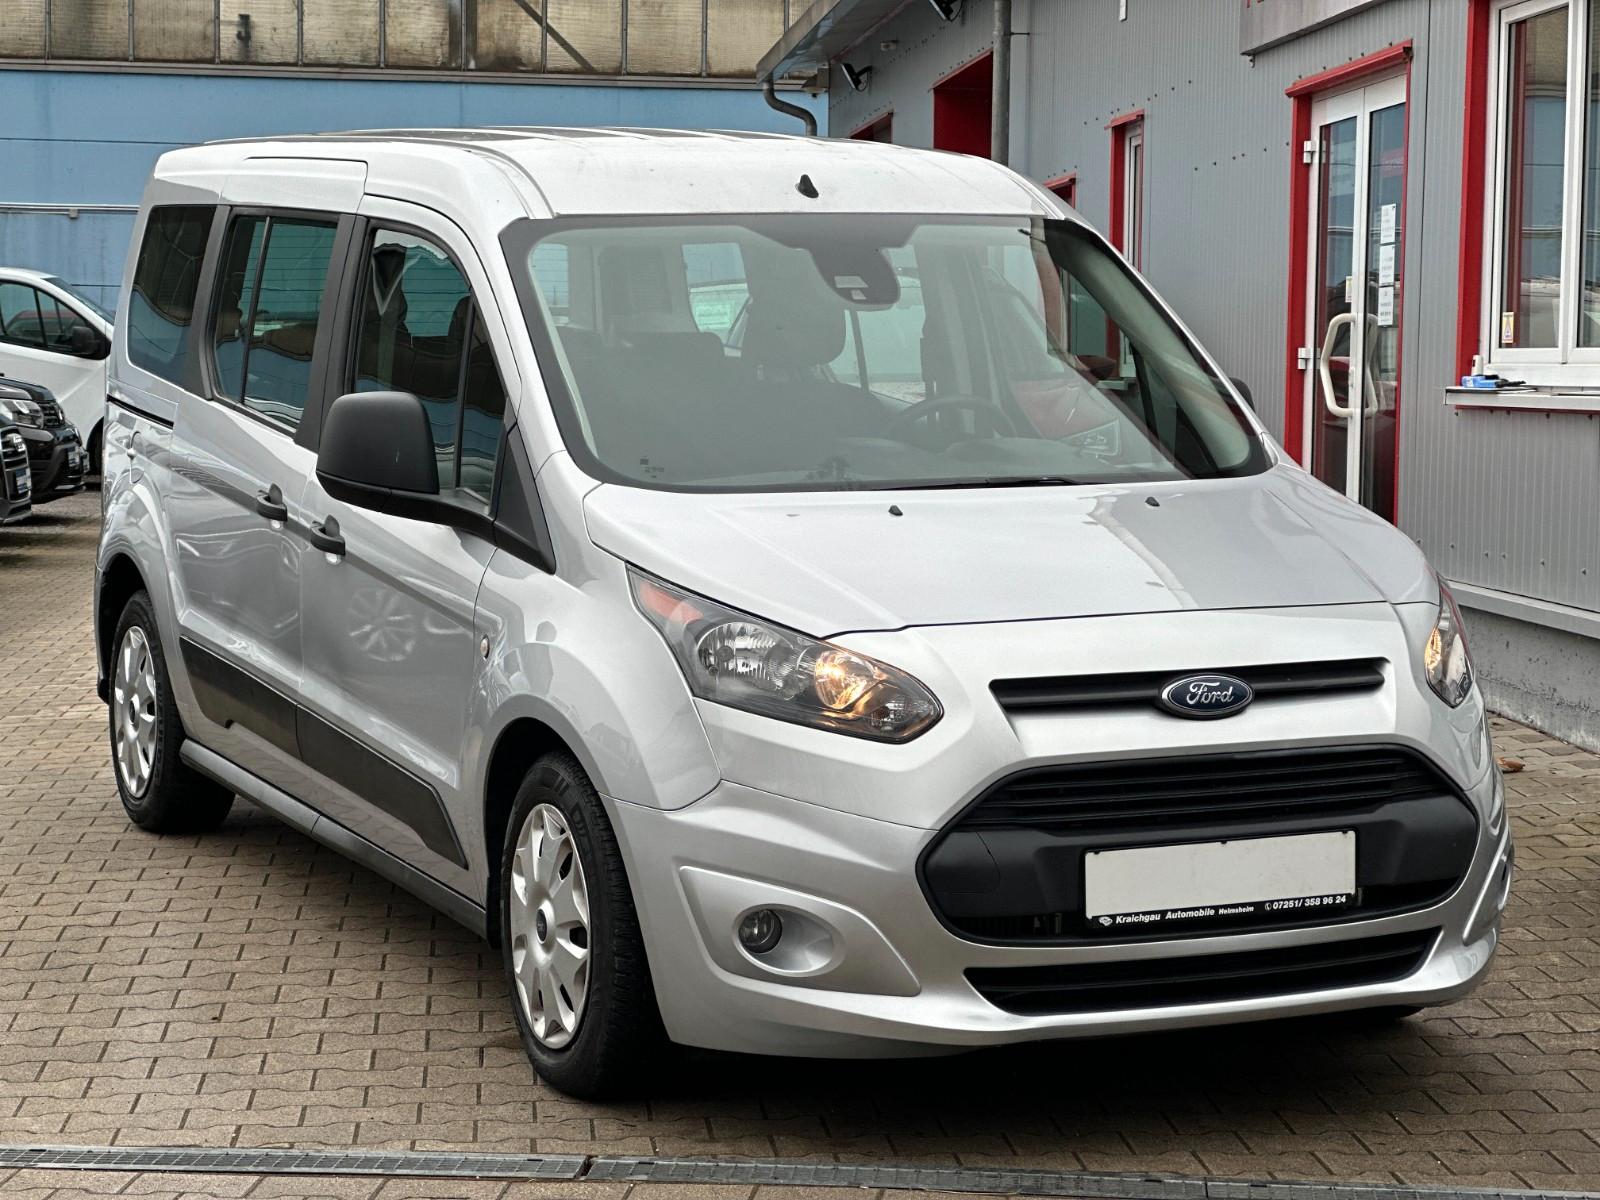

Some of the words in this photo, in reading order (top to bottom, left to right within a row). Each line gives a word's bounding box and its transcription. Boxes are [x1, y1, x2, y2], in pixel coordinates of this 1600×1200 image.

[1186, 681, 1234, 705] Ford
[1115, 913, 1161, 924] Kraichgau
[1165, 907, 1215, 920] Automobile
[1304, 897, 1321, 907] 358
[1322, 896, 1333, 905] 96
[1335, 894, 1347, 904] 24
